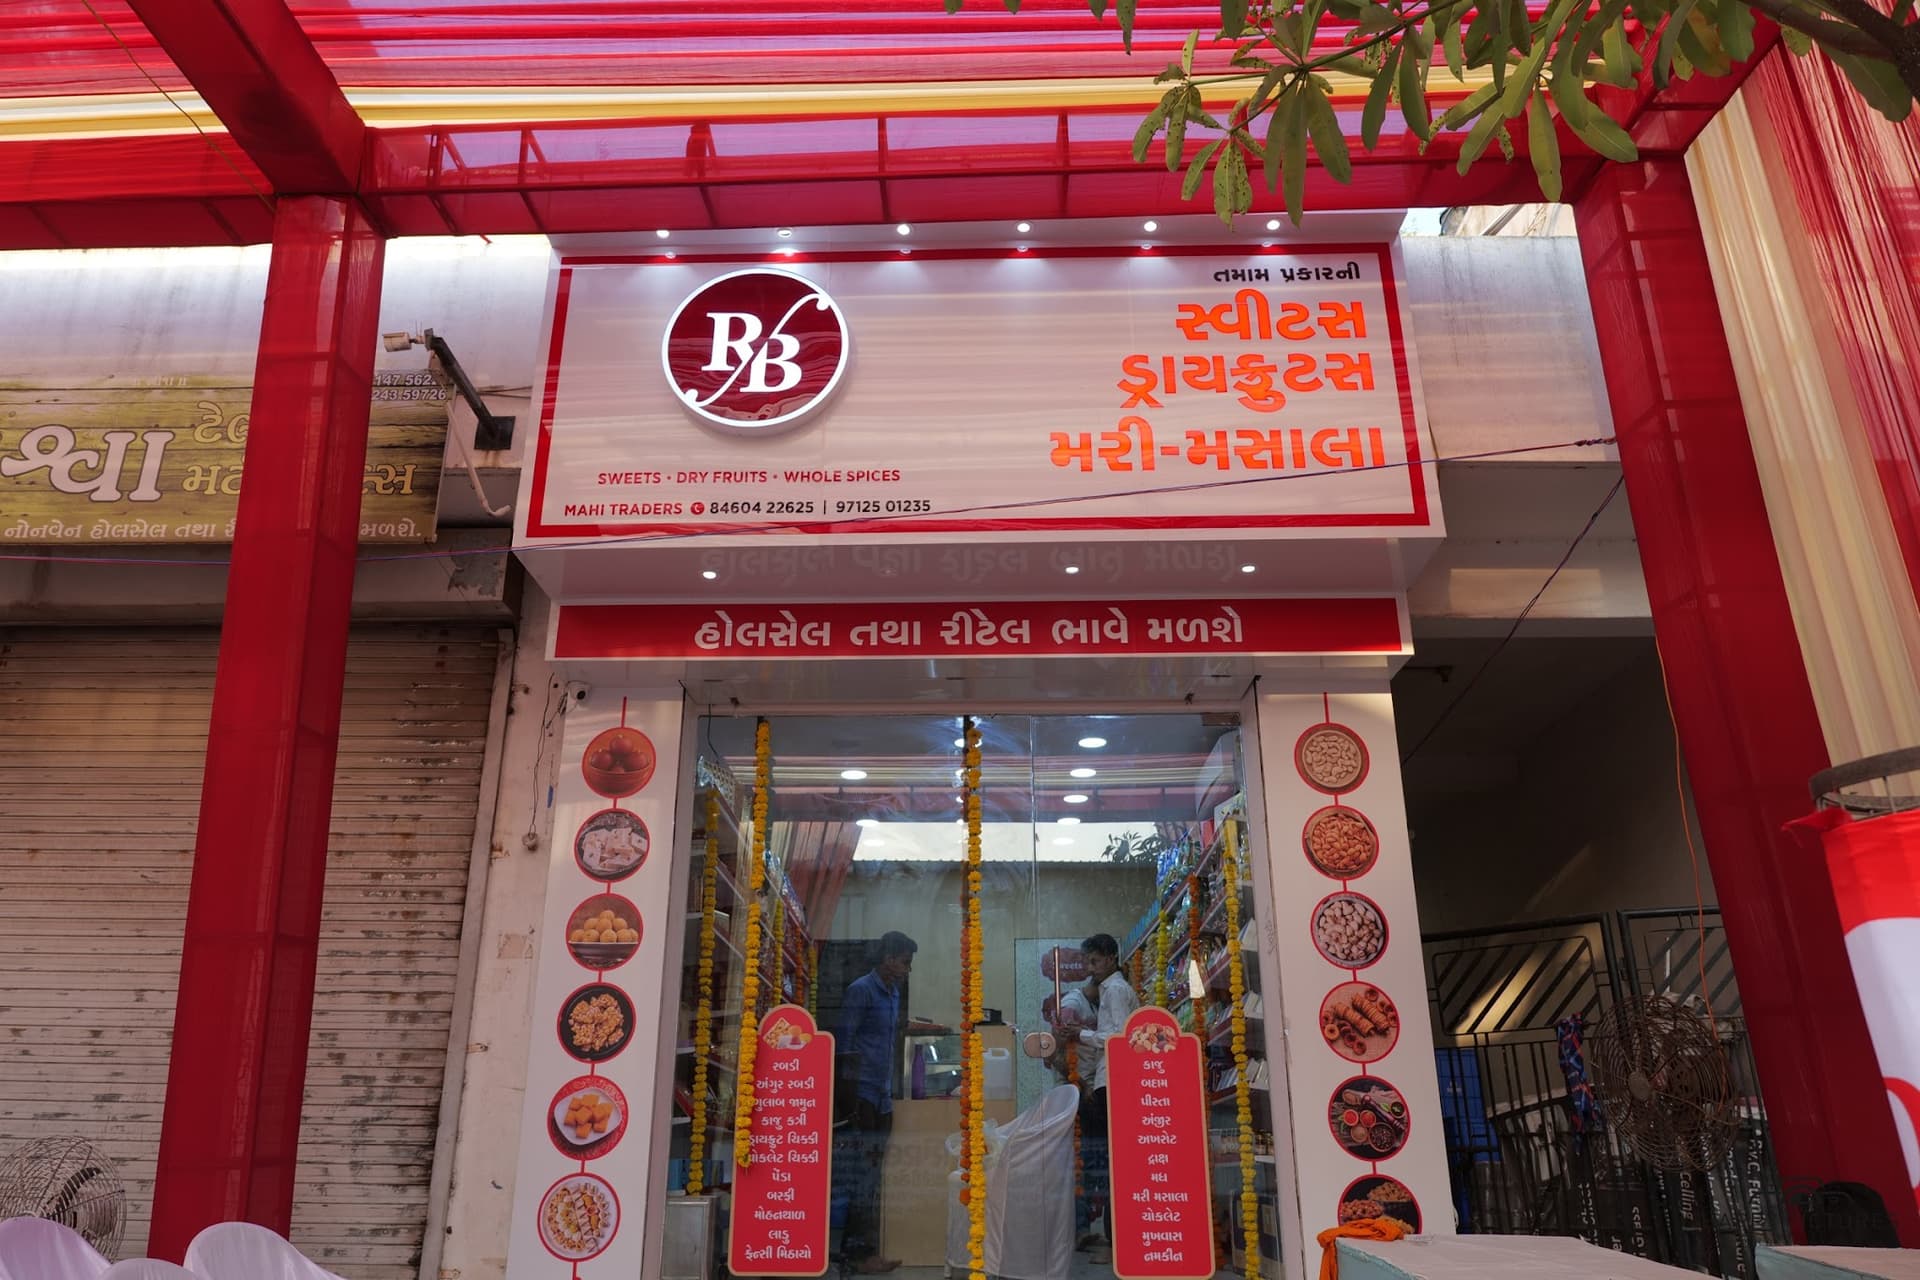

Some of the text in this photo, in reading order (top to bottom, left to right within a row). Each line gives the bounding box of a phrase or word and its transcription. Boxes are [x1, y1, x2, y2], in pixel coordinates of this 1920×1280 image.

[1214, 261, 1360, 282] તમામ પ્રકારની
[1176, 288, 1367, 341] સ્વીટસ
[1049, 416, 1385, 472] મરી-મસાલા
[598, 470, 900, 484] SWEETS DRY FRUITS WHOLE SPICES
[565, 500, 930, 516] MAHI TRADERS 84604 22625 97125 01235
[89, 519, 167, 539] હોલસેલ
[175, 523, 216, 538] તથા
[694, 606, 1243, 650] હોલસેલ તથા રીટેલ ભાવે મળશે
[773, 1059, 800, 1071] રબડી
[1143, 1060, 1165, 1074] કાજુ
[1141, 1079, 1167, 1088] બદામ
[1151, 1173, 1167, 1182] મધ
[1133, 1189, 1188, 1202] મરી મસાલા
[1142, 1207, 1180, 1222] ચોકલેટ
[1144, 1248, 1183, 1261] નમકીન
